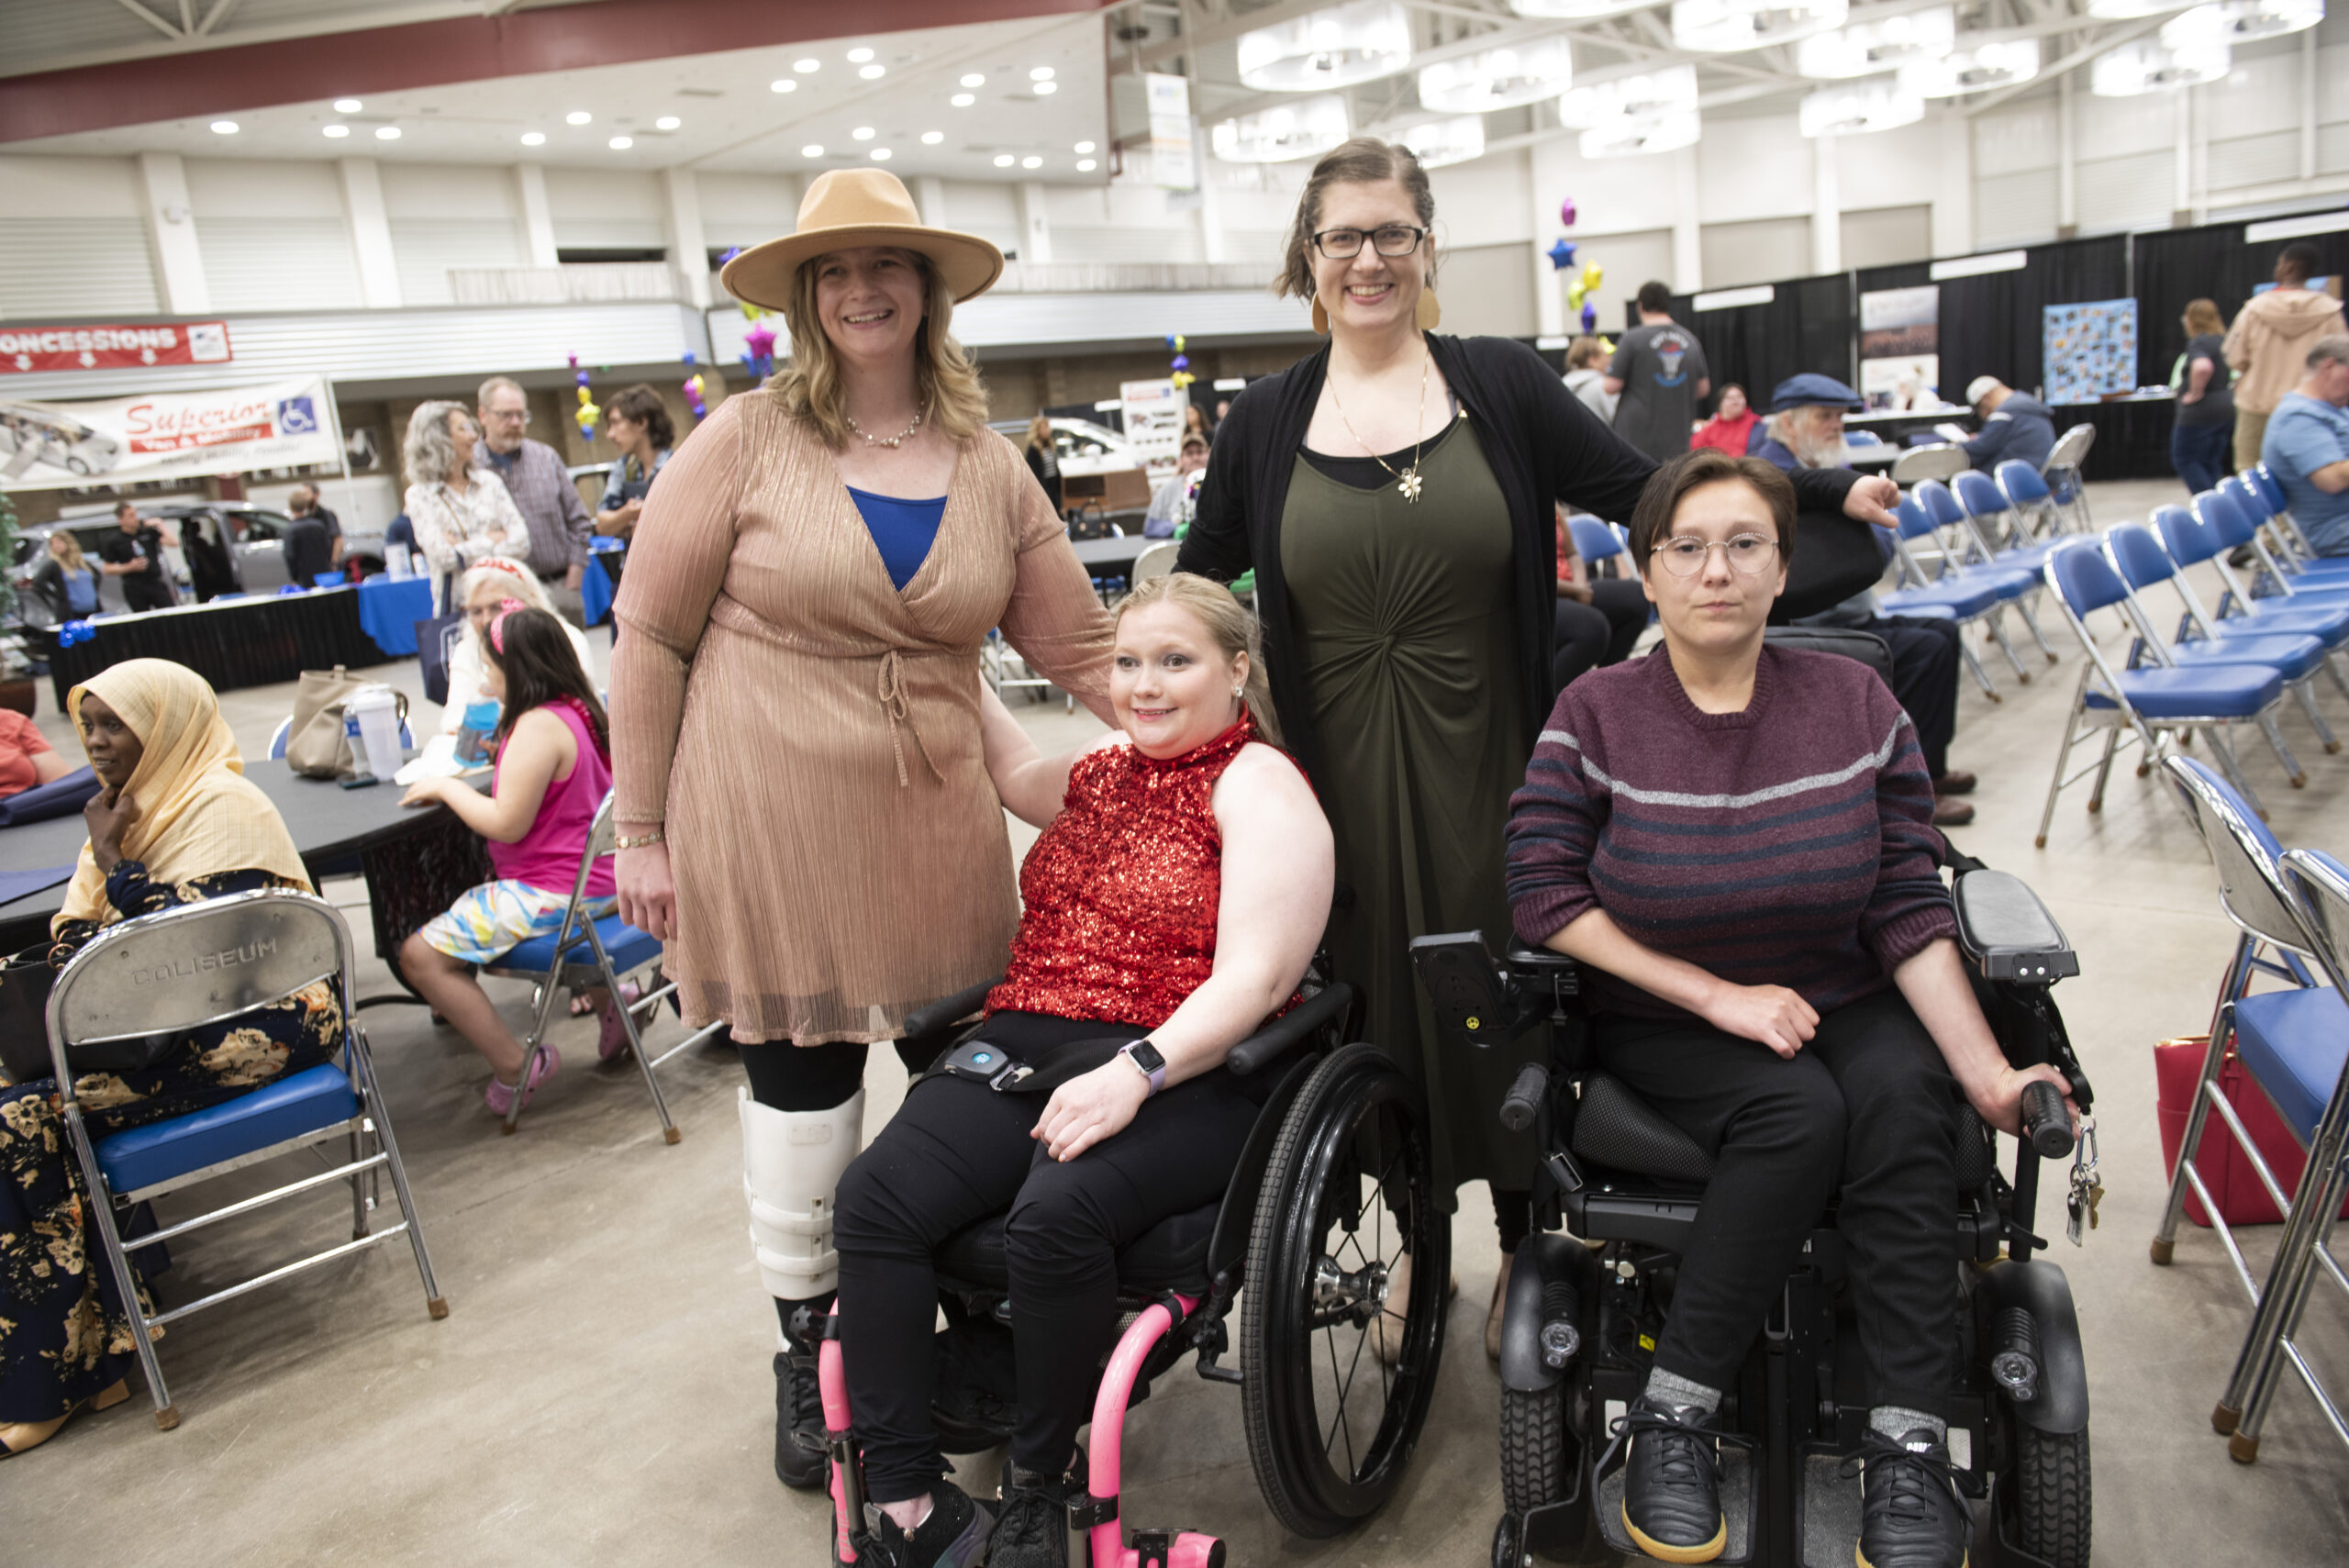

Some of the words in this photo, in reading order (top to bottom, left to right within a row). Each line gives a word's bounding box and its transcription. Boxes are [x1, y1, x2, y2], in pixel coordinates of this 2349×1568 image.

[0, 328, 177, 354] ONCESSIONS
[126, 401, 269, 436] Superior
[139, 439, 176, 450] Van
[179, 436, 195, 448] &
[196, 427, 262, 445] Mobility
[132, 938, 278, 985] COLISEUM
[1907, 1442, 1932, 1452] NIK
